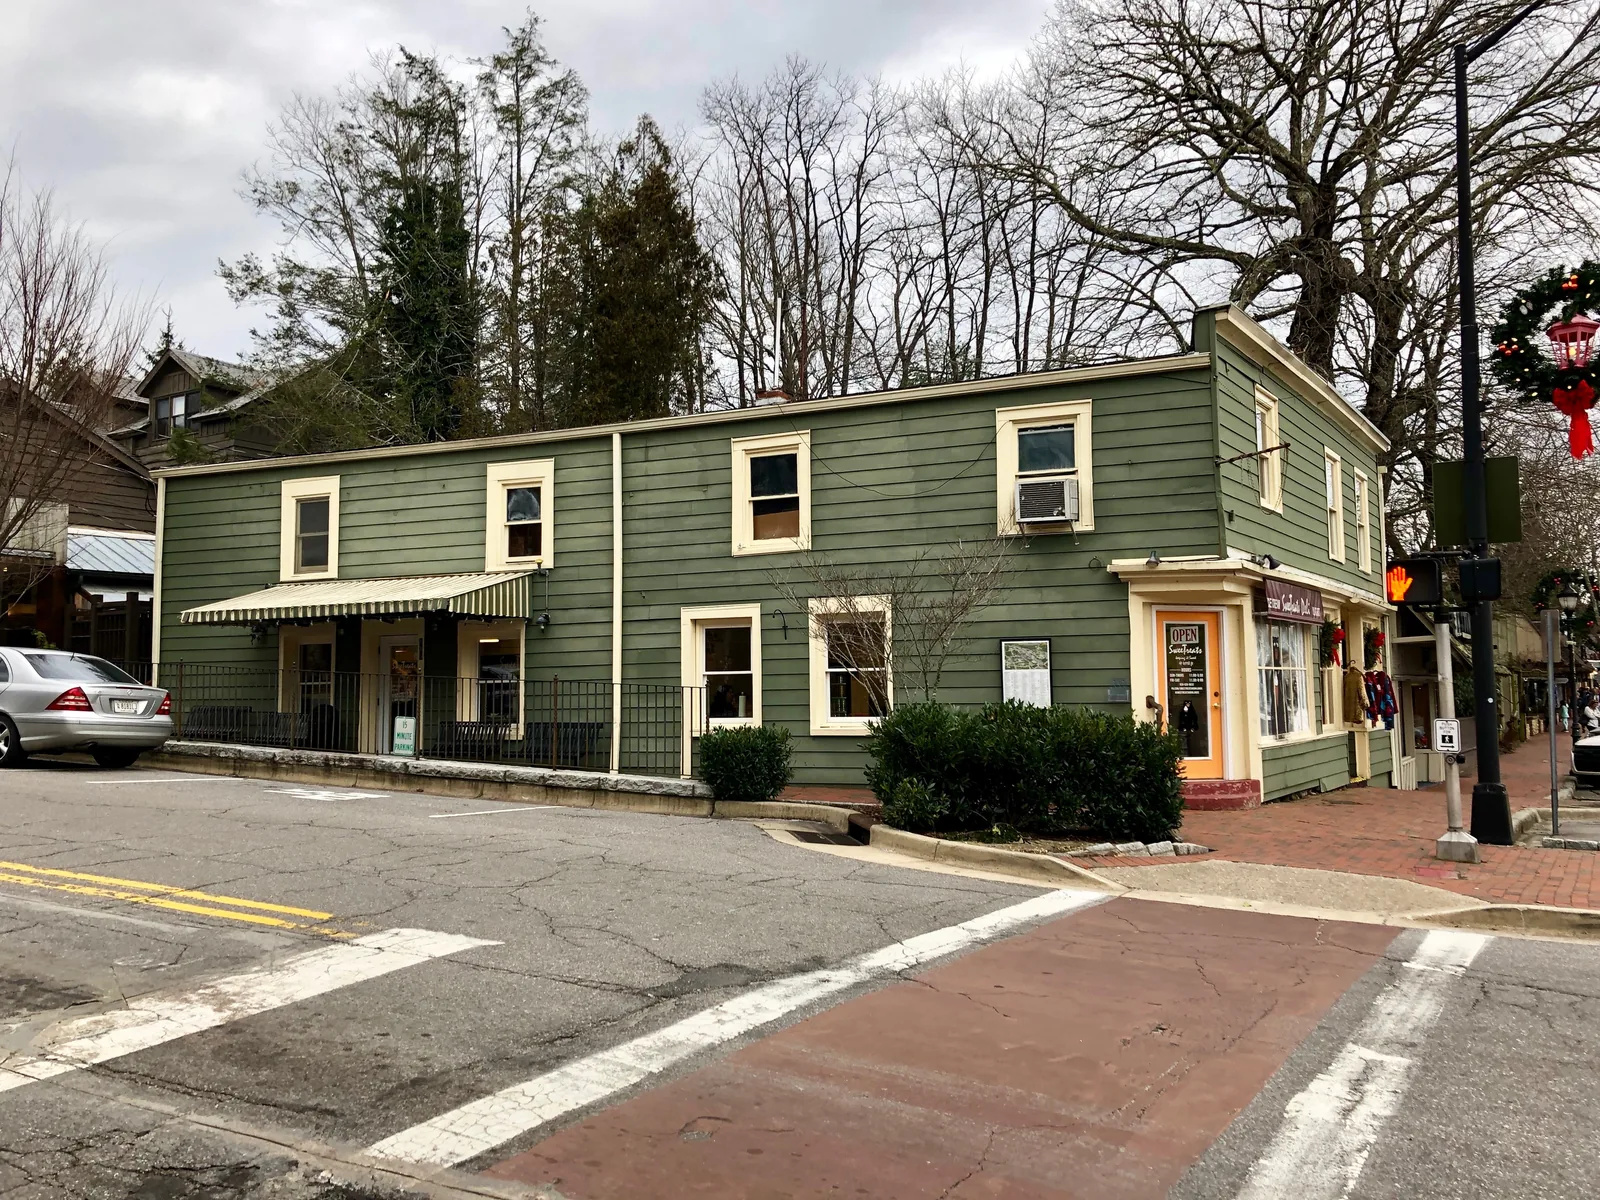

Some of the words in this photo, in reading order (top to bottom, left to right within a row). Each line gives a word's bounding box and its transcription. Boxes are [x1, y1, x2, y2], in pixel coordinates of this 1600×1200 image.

[1172, 628, 1197, 643] OPEN
[1168, 644, 1203, 655] SweeTreats
[402, 721, 408, 729] 15
[396, 732, 412, 740] MINUTE
[394, 743, 413, 751] PARKING
